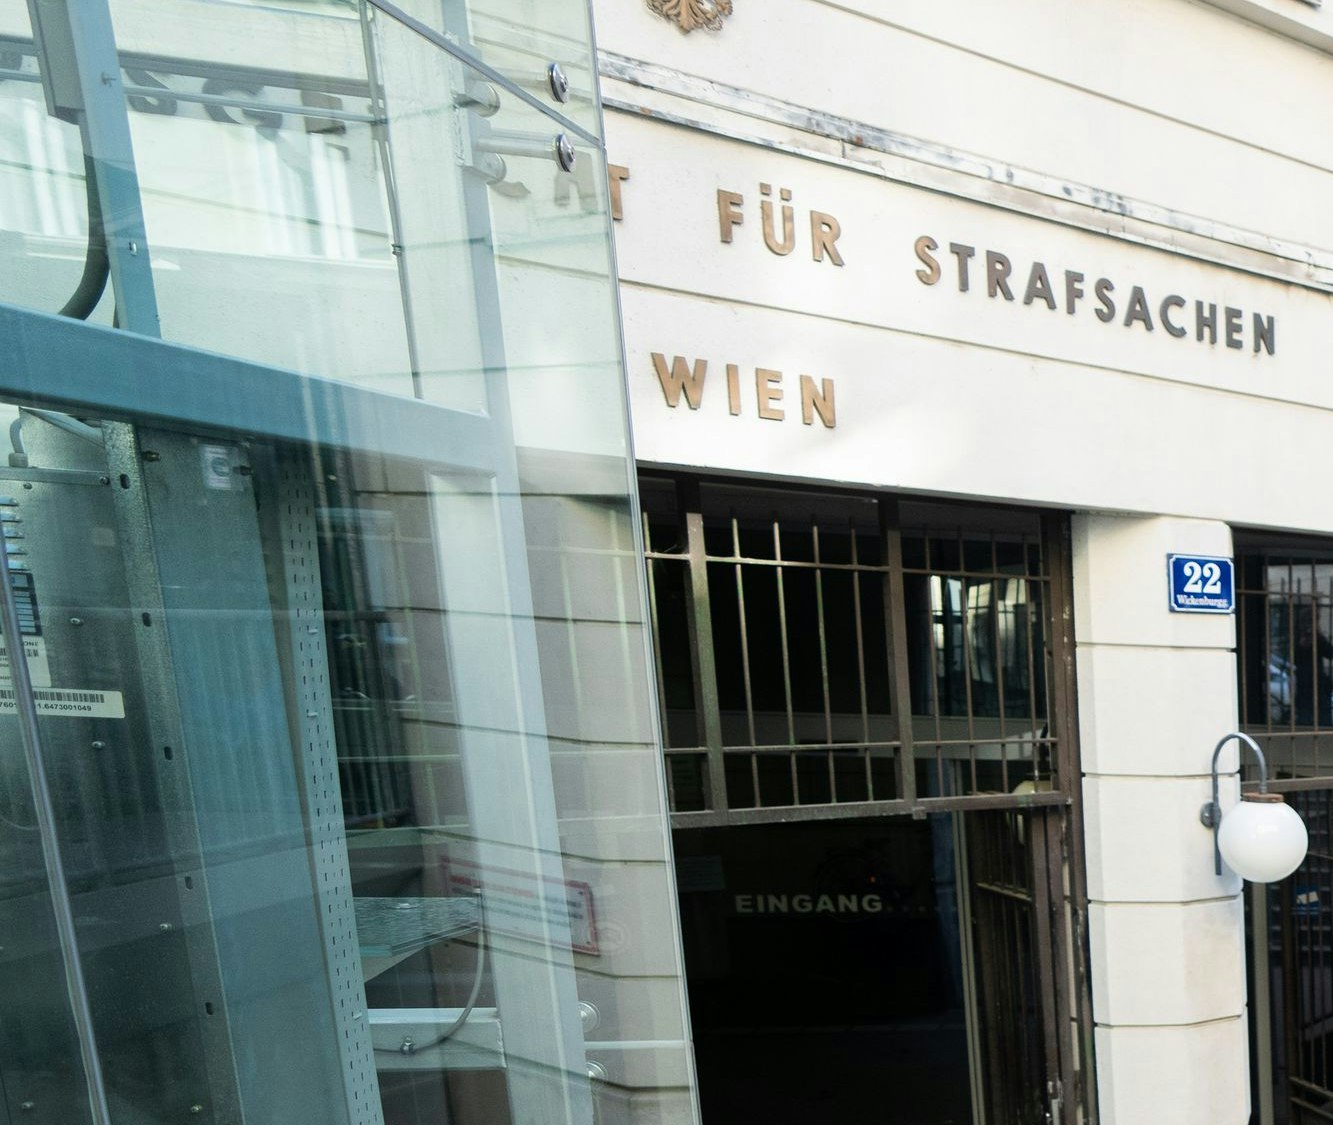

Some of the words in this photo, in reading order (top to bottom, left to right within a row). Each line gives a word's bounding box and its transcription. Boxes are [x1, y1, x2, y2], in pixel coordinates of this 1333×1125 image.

[716, 183, 845, 268] FÜR
[914, 236, 1277, 356] STRAFSACHEN
[651, 352, 838, 431] WIEN
[1183, 561, 1221, 593] 22
